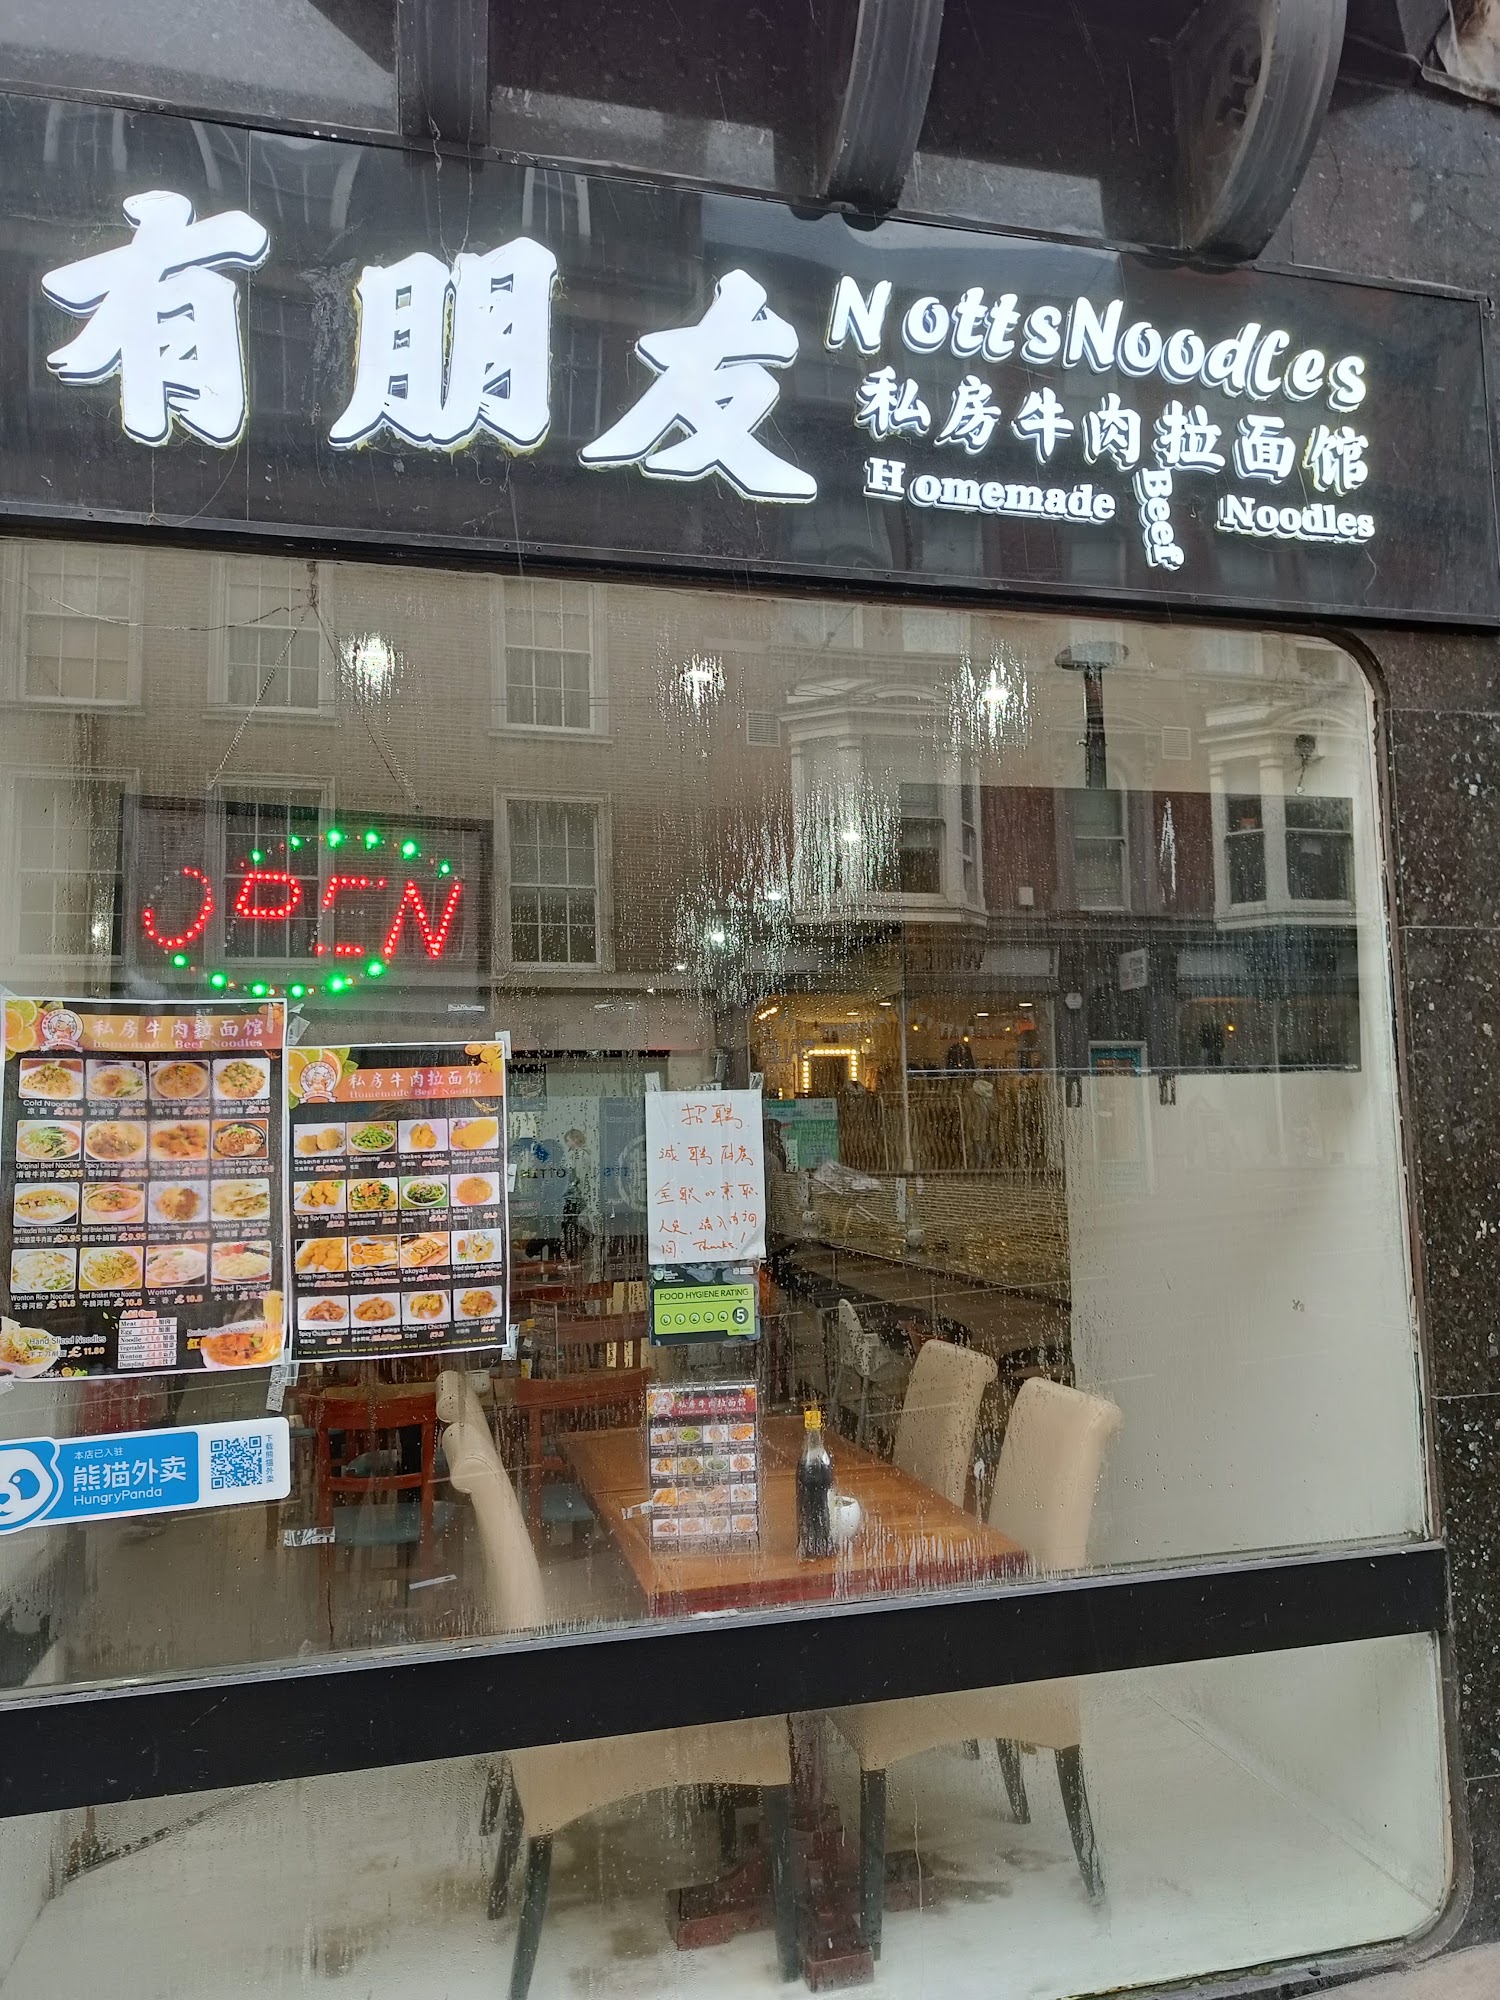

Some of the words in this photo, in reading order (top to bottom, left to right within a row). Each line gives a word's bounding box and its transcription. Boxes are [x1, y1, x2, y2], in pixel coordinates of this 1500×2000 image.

[42, 190, 818, 503] 有朋友
[855, 365, 1371, 497] 私房牛肉拉面馆
[863, 457, 1116, 524] Homemade
[1132, 467, 1184, 571] Beef
[1217, 494, 1375, 543] Noodles
[44, 1100, 76, 1108] Noodles
[15, 1162, 40, 1170] Original
[53, 1234, 81, 1244] £9.95
[118, 1232, 147, 1242] £9.95
[400, 1267, 429, 1275] Takoyaki
[660, 1292, 684, 1301] FOOD
[685, 1290, 720, 1299] HYGIENE
[720, 1288, 749, 1297] RATING
[735, 1309, 745, 1323] 5
[29, 1337, 50, 1345] Hand
[75, 1334, 107, 1344] Noodles
[74, 1447, 124, 1461] 本店已入驻
[72, 1455, 187, 1493] 熊猫外卖
[73, 1486, 163, 1506] HungryPanda
